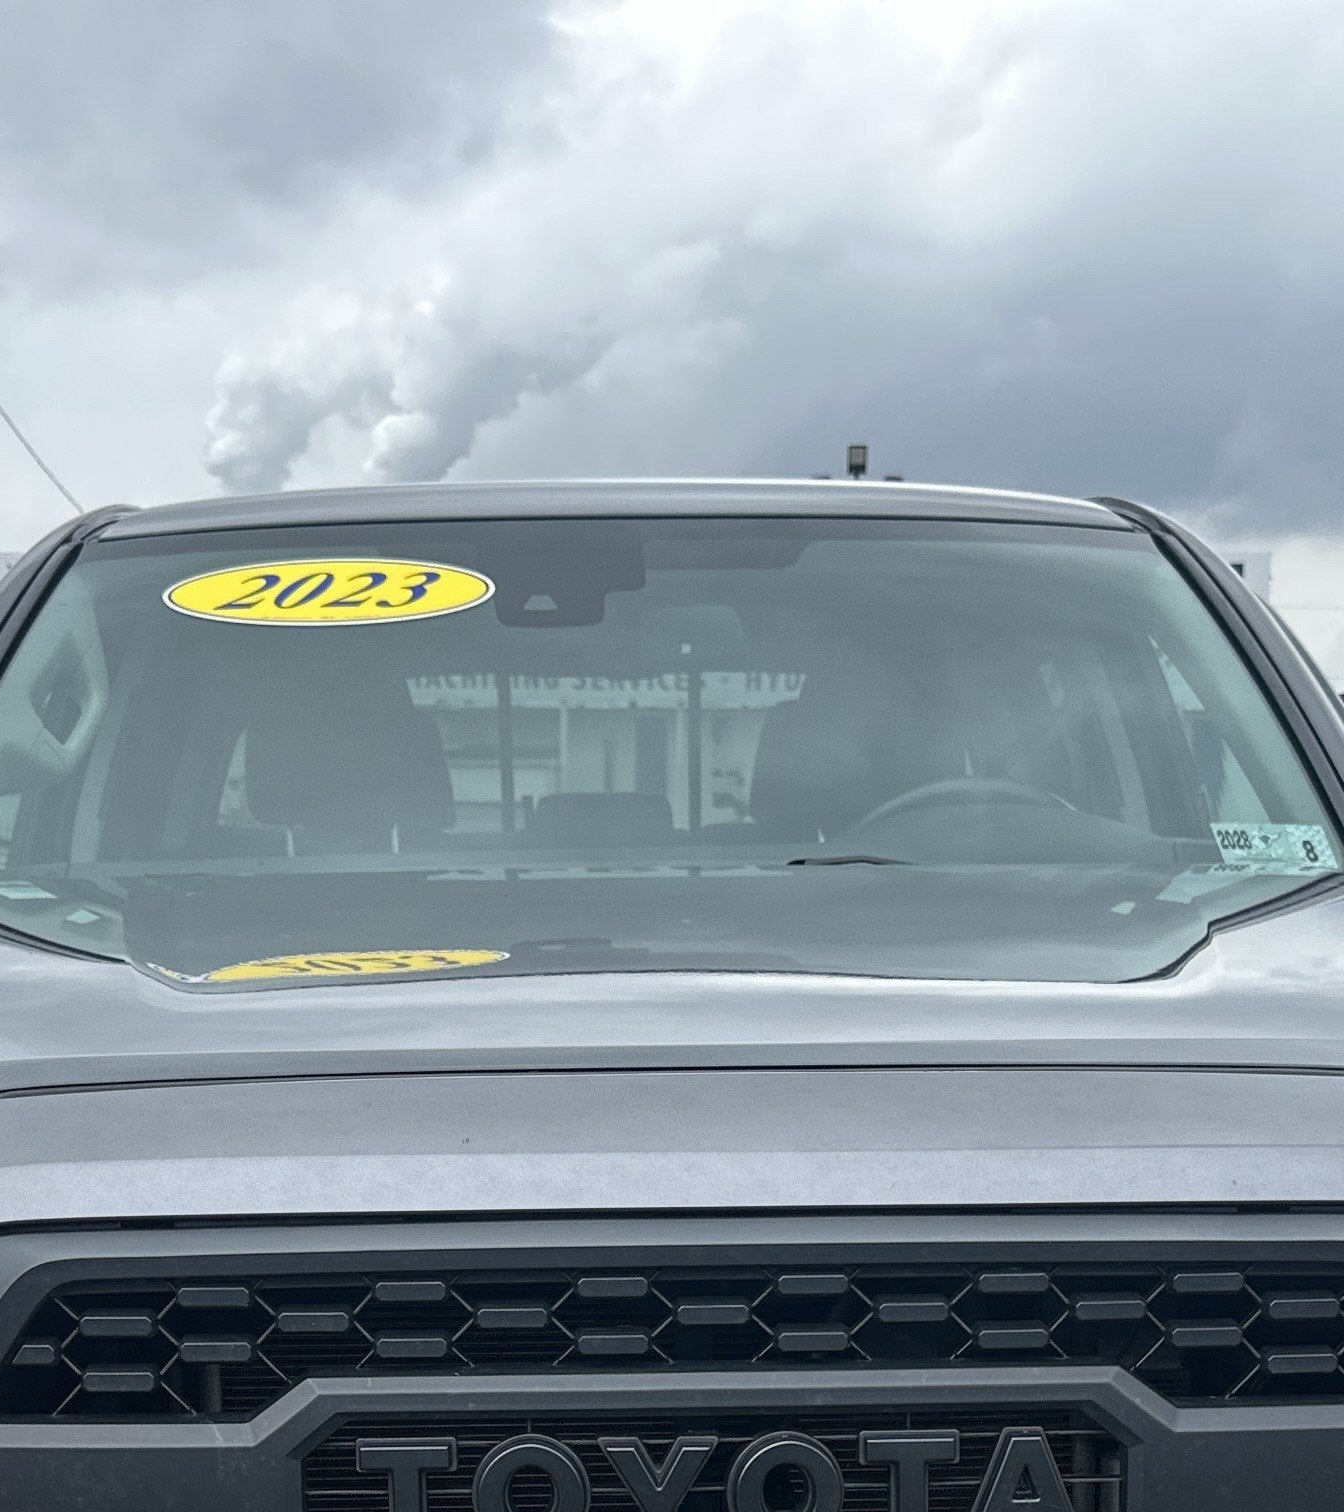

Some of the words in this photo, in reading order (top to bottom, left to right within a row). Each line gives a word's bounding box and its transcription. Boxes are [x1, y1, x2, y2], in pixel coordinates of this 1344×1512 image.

[213, 571, 442, 611] 2023
[1217, 830, 1253, 850] 2028
[1302, 840, 1319, 863] 8
